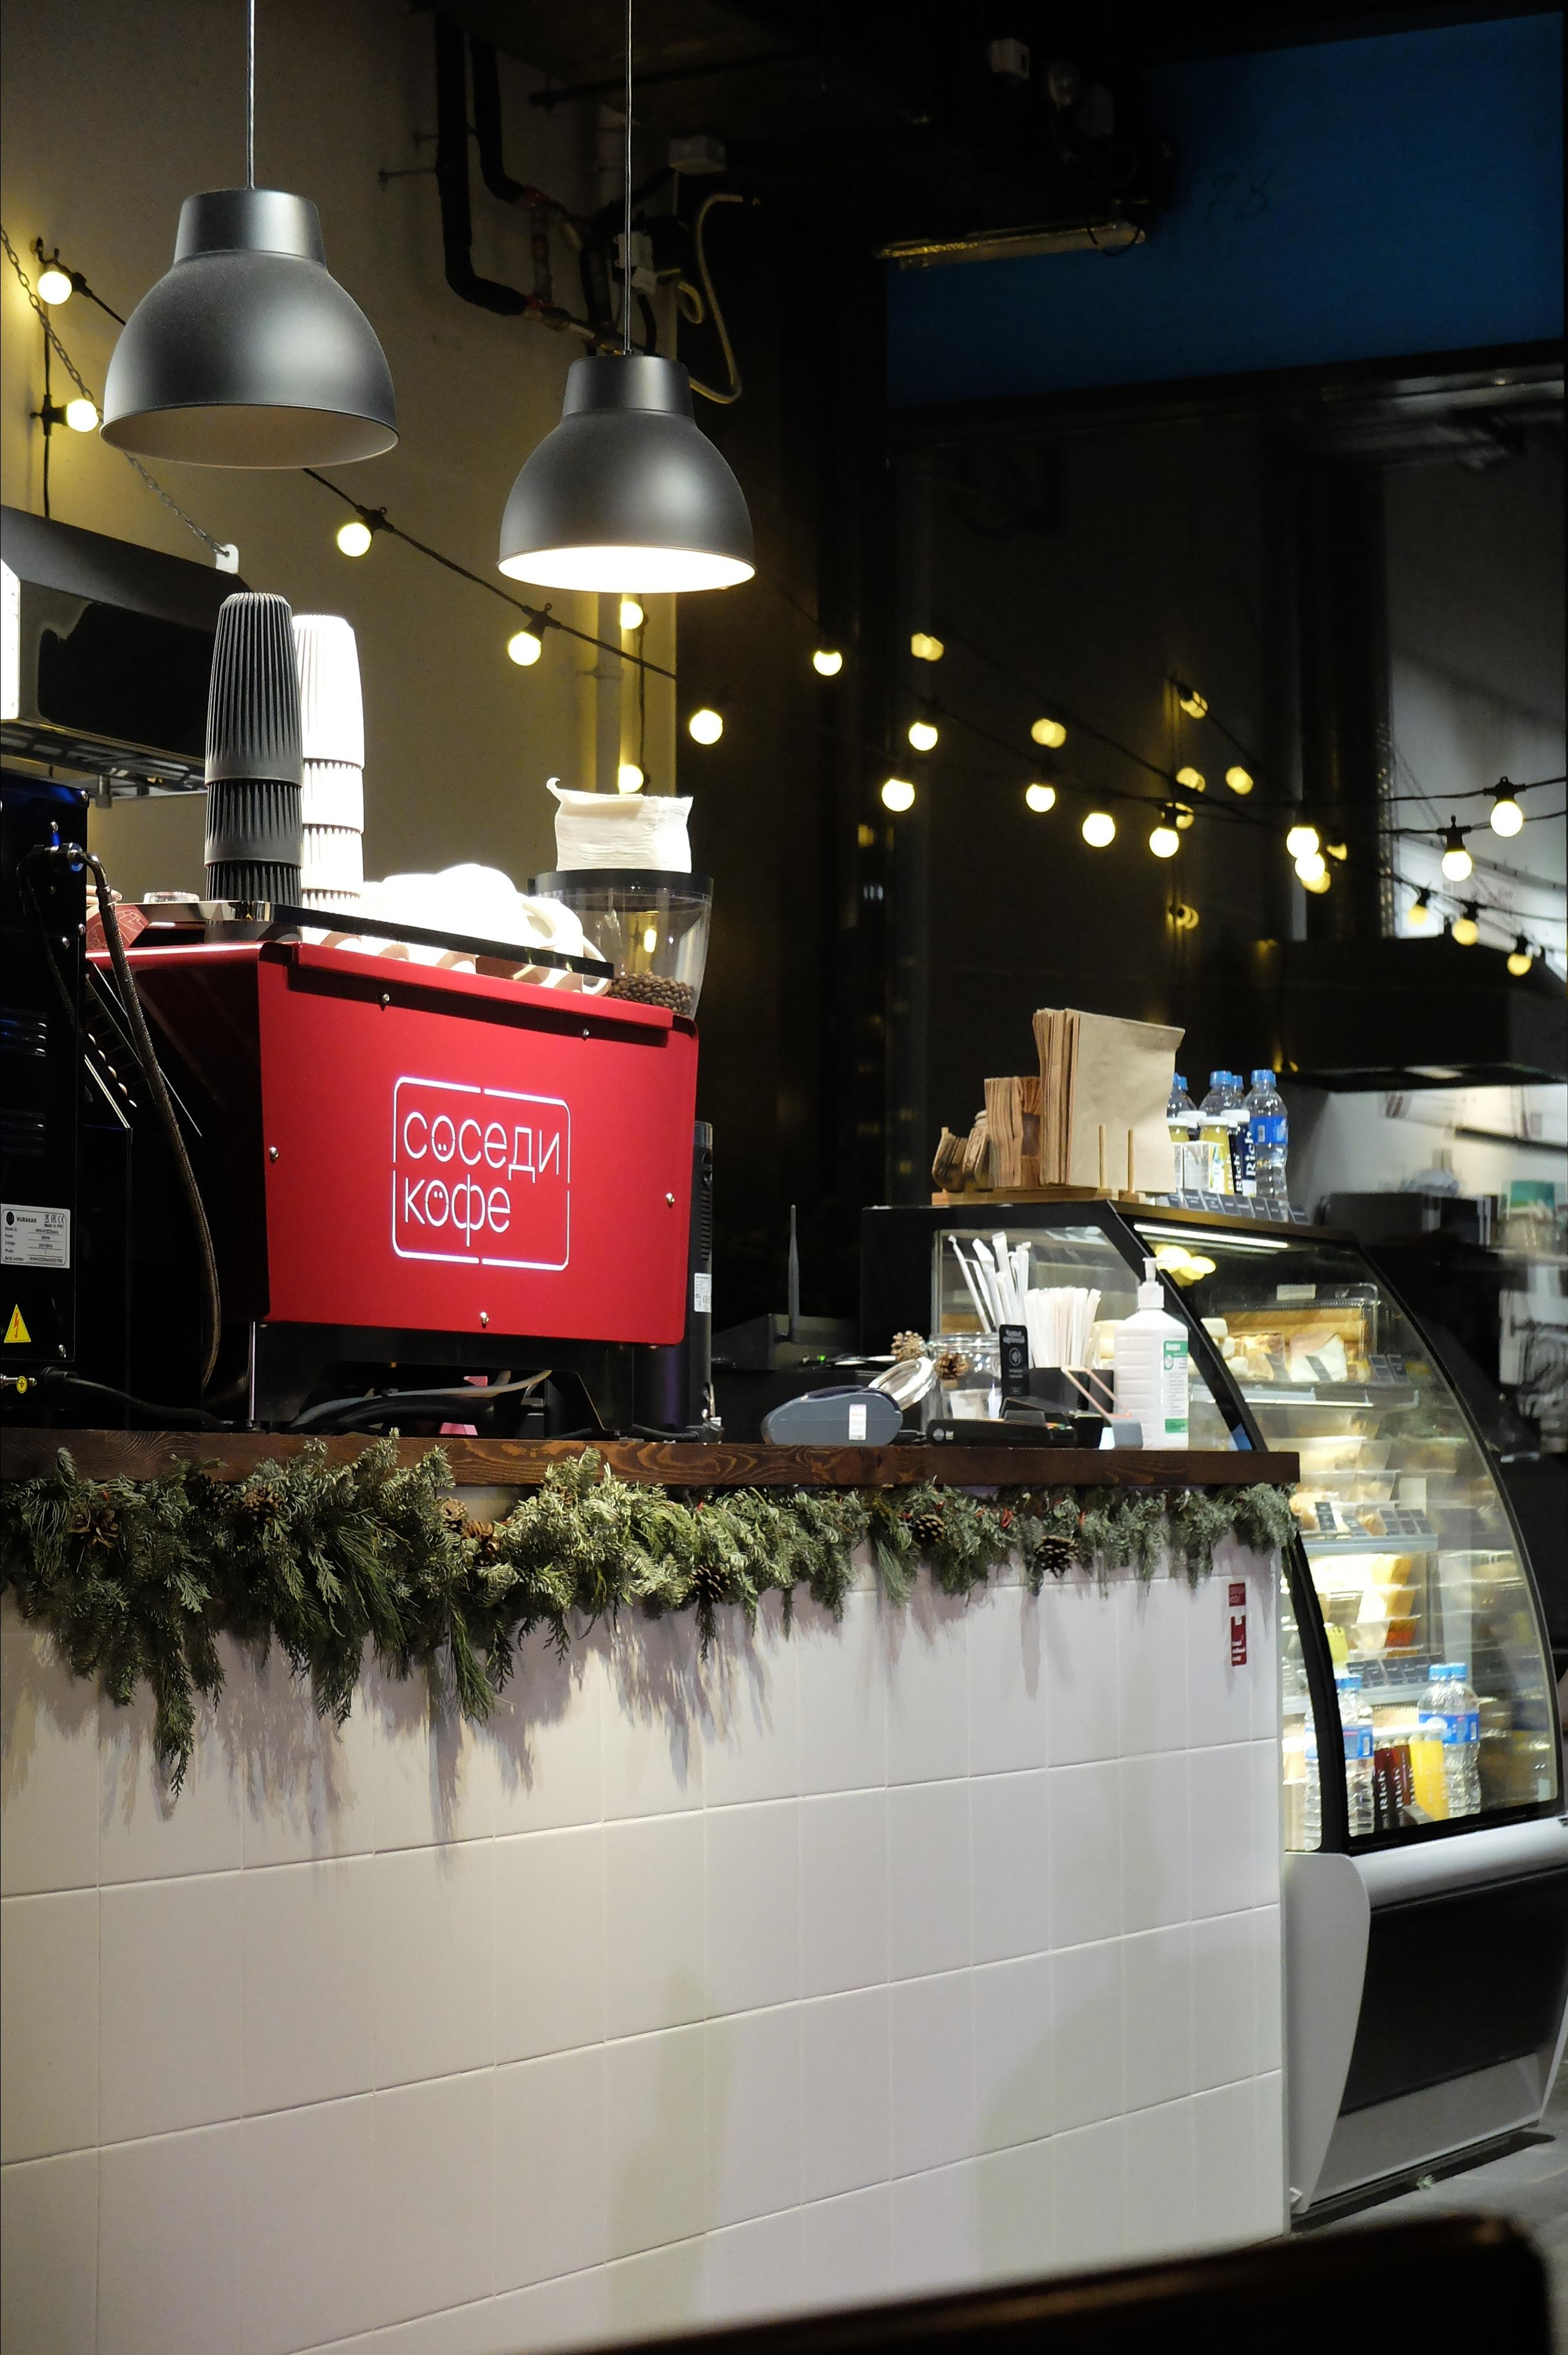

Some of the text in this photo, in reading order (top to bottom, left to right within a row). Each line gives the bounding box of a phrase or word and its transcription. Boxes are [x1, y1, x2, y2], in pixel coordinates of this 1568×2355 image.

[404, 1111, 559, 1183] соседи
[1245, 1131, 1256, 1176] Rich
[1233, 1154, 1243, 1192] Rich
[404, 1174, 511, 1247] кофе
[1378, 1770, 1388, 1810] Rich
